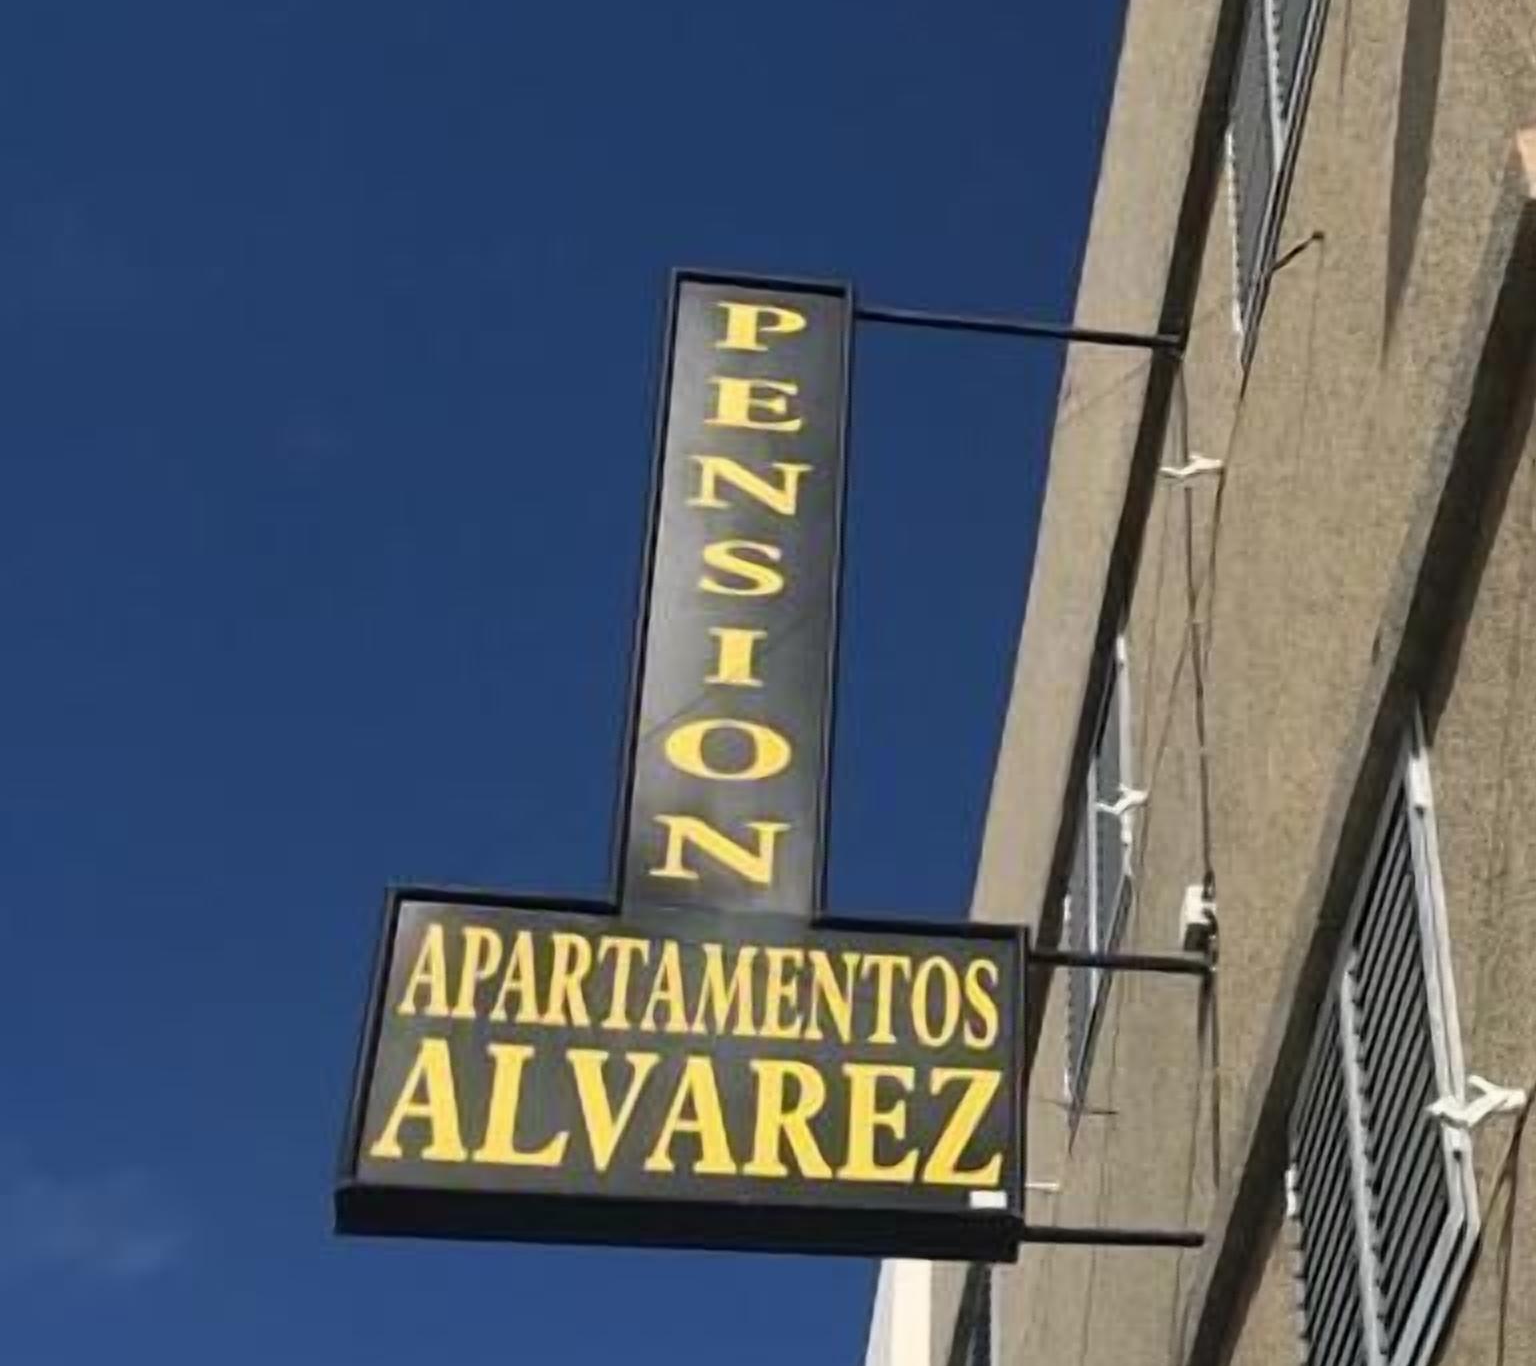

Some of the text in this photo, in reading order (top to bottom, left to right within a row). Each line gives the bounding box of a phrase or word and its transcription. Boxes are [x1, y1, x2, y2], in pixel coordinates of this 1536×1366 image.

[649, 299, 809, 886] PENSION
[397, 921, 1000, 1051] APARTAMENTOS
[370, 1036, 1004, 1188] ALVAREZ
